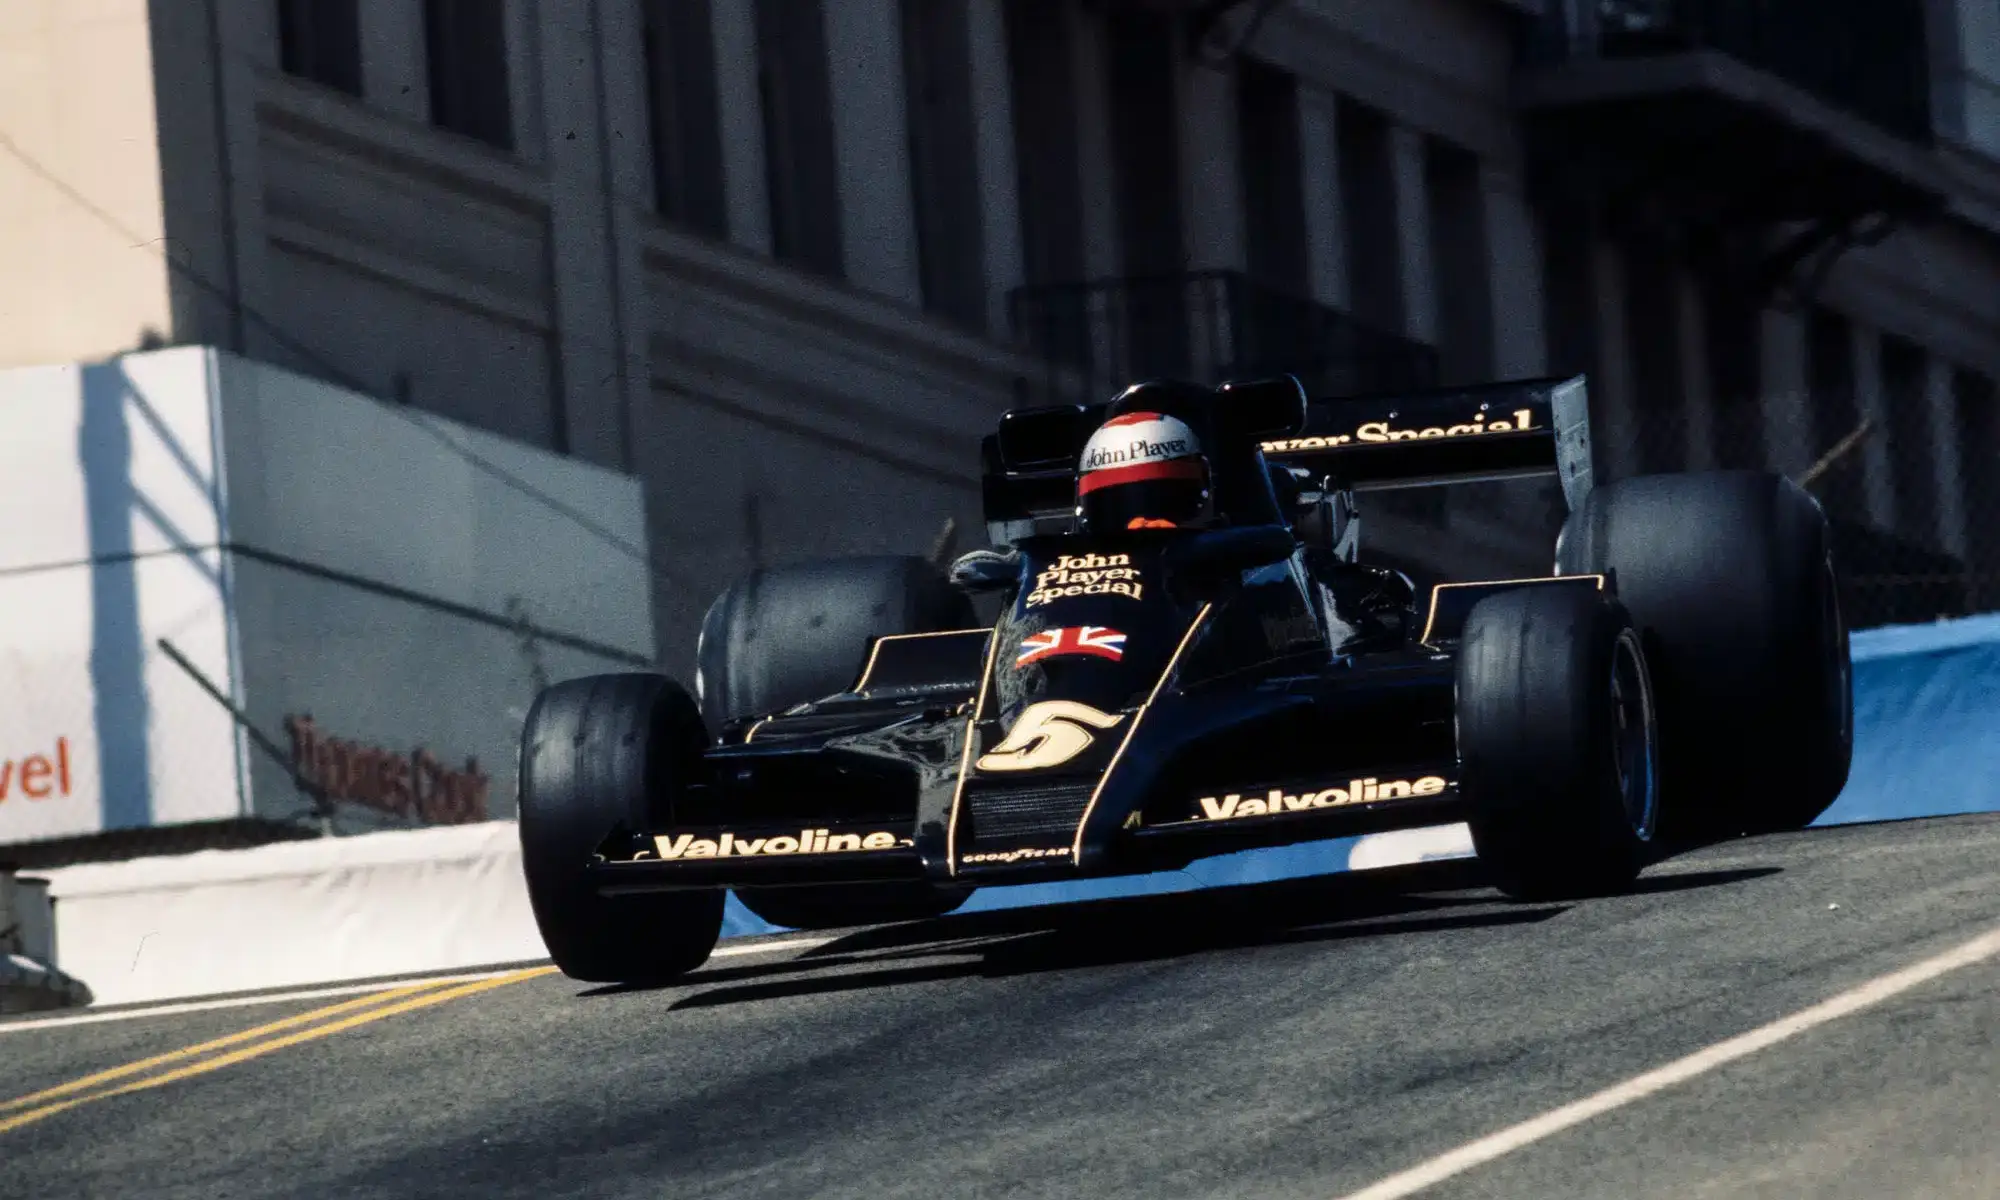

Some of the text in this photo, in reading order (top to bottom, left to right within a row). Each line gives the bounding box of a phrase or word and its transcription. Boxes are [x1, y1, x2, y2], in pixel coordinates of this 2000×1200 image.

[1086, 437, 1187, 469] John Player
[1048, 552, 1130, 572] John
[1036, 566, 1141, 591] Player
[1025, 581, 1143, 610] Special
[976, 700, 1126, 771] 5
[1200, 775, 1446, 821] Valvoline
[653, 828, 896, 860] Valvoline
[962, 848, 1069, 863] GOODYEAR
